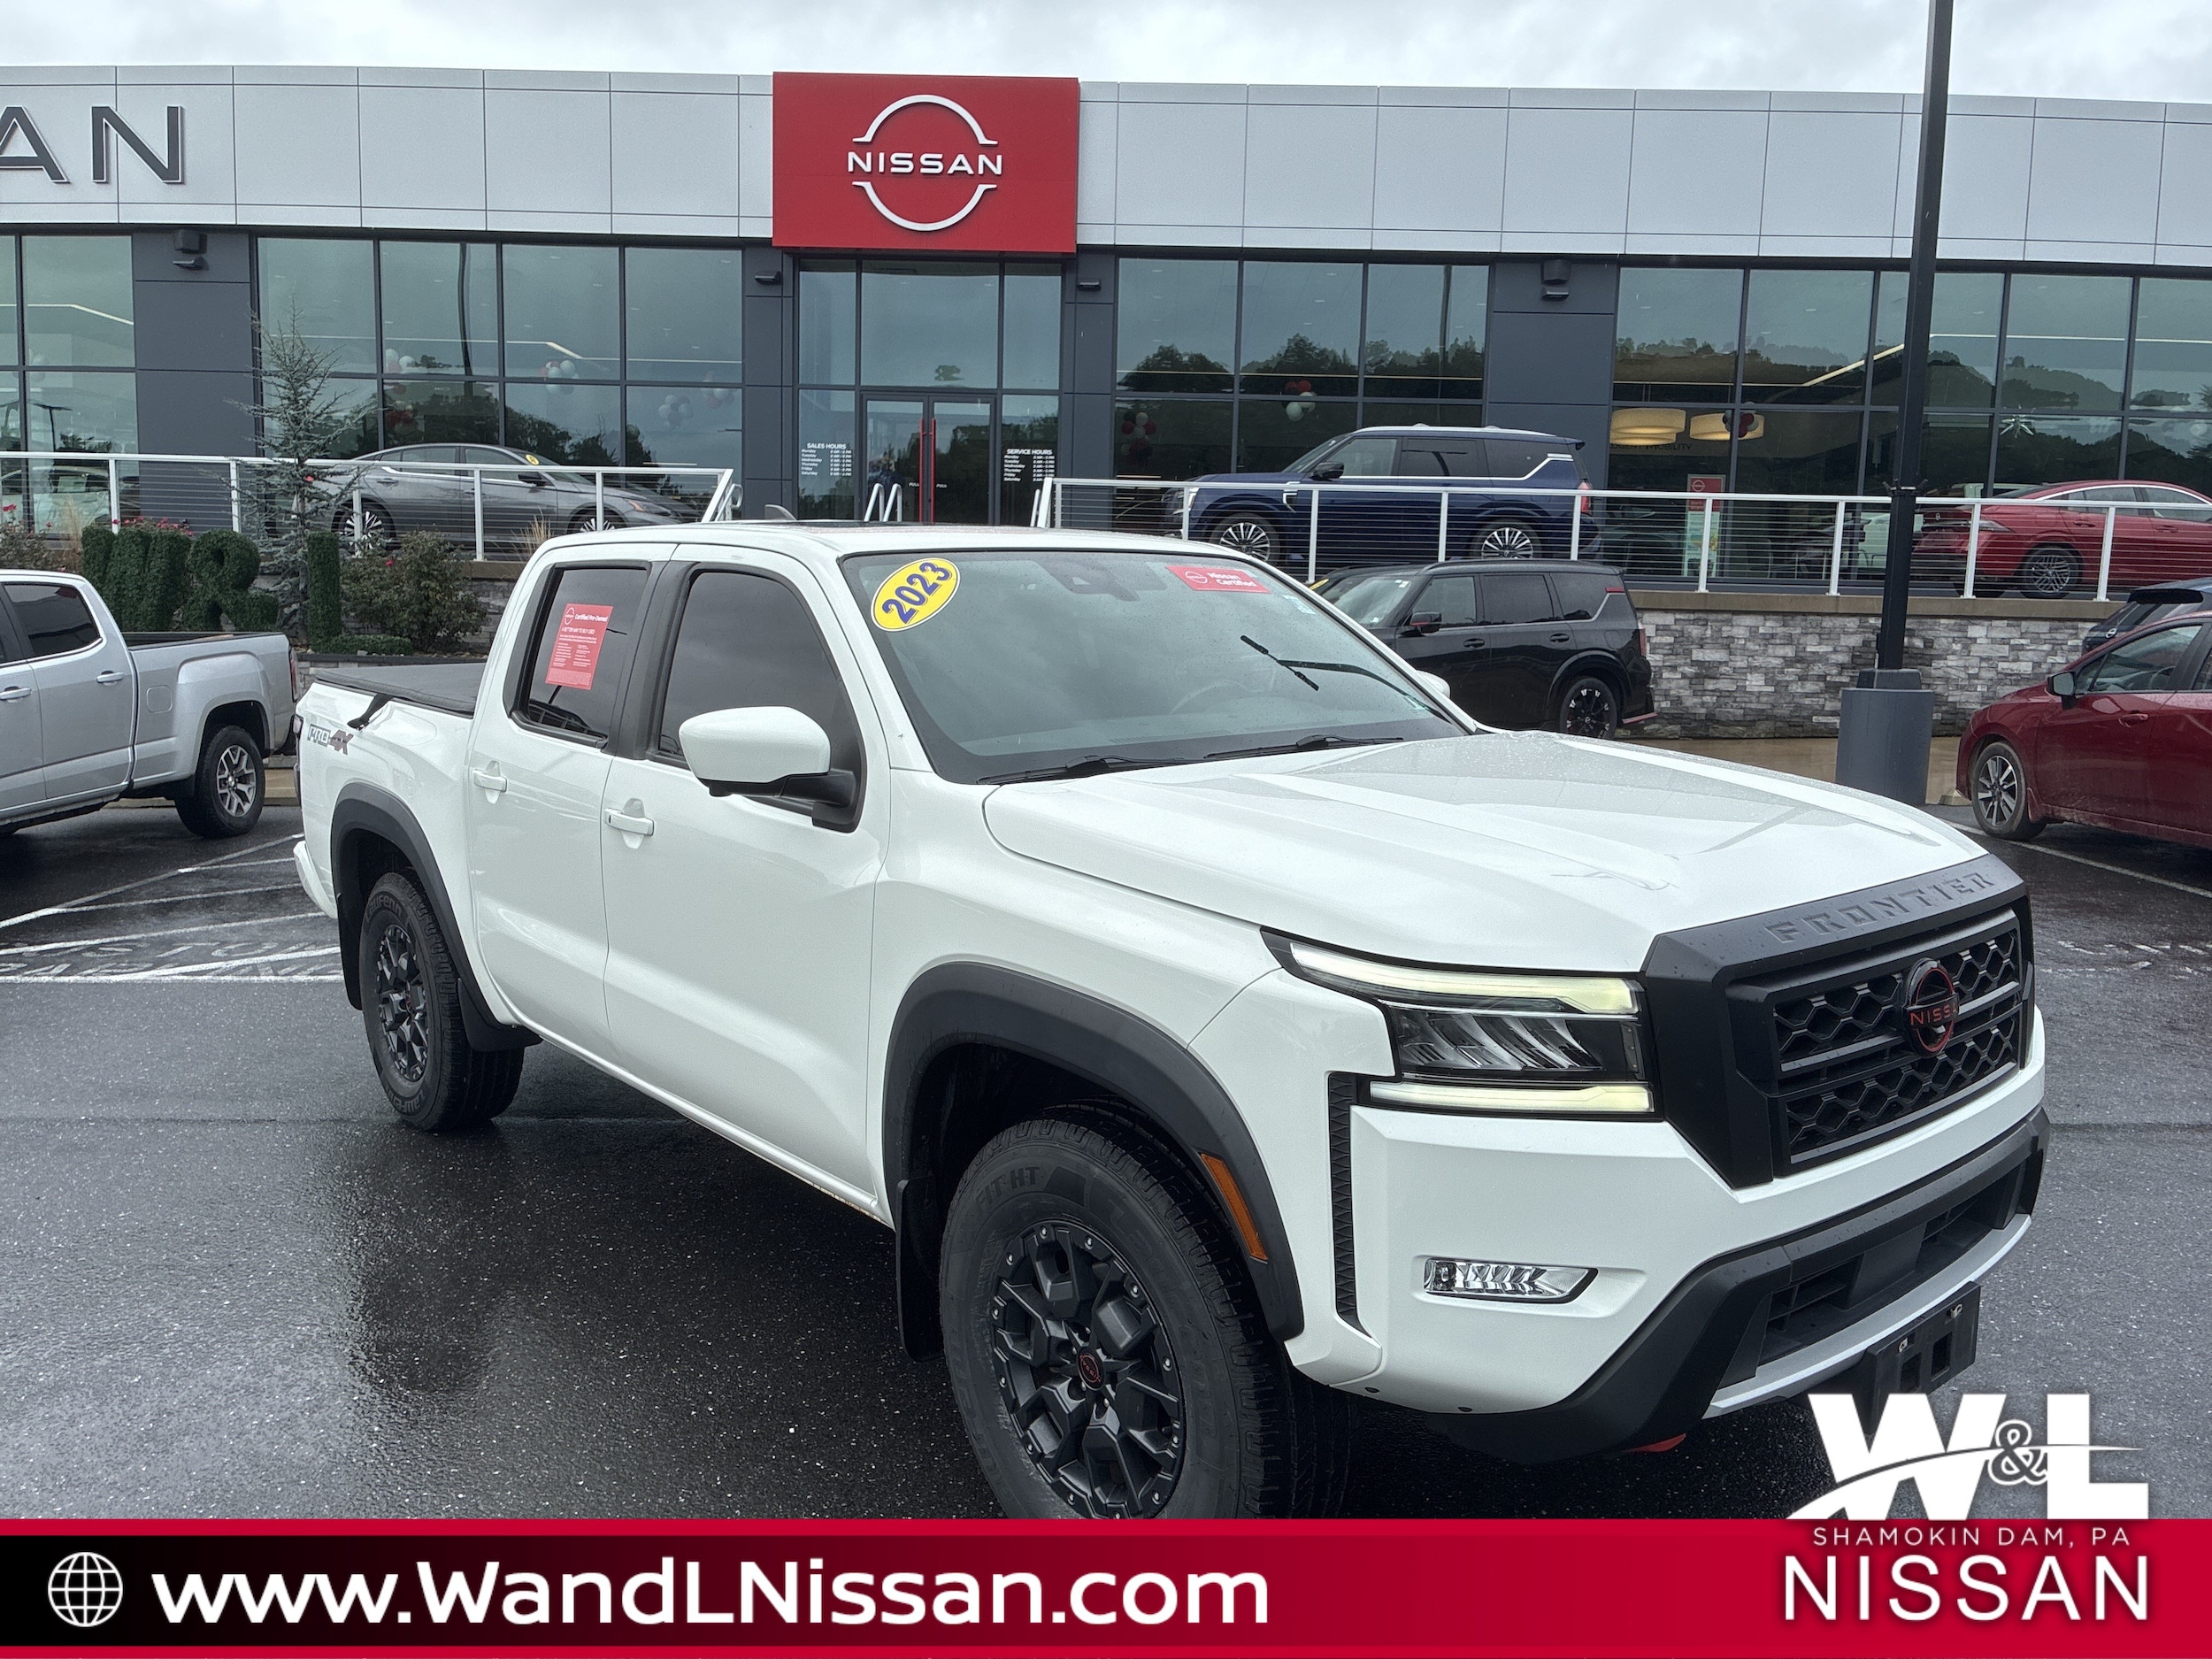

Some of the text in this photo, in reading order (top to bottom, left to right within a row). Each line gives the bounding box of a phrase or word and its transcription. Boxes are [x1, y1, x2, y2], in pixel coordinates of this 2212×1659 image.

[847, 151, 1002, 176] NISSAN
[881, 562, 952, 625] 2023
[307, 724, 354, 756] PRO-4X
[1763, 872, 1995, 944] FRONTIER
[1010, 1166, 1041, 1189] HT
